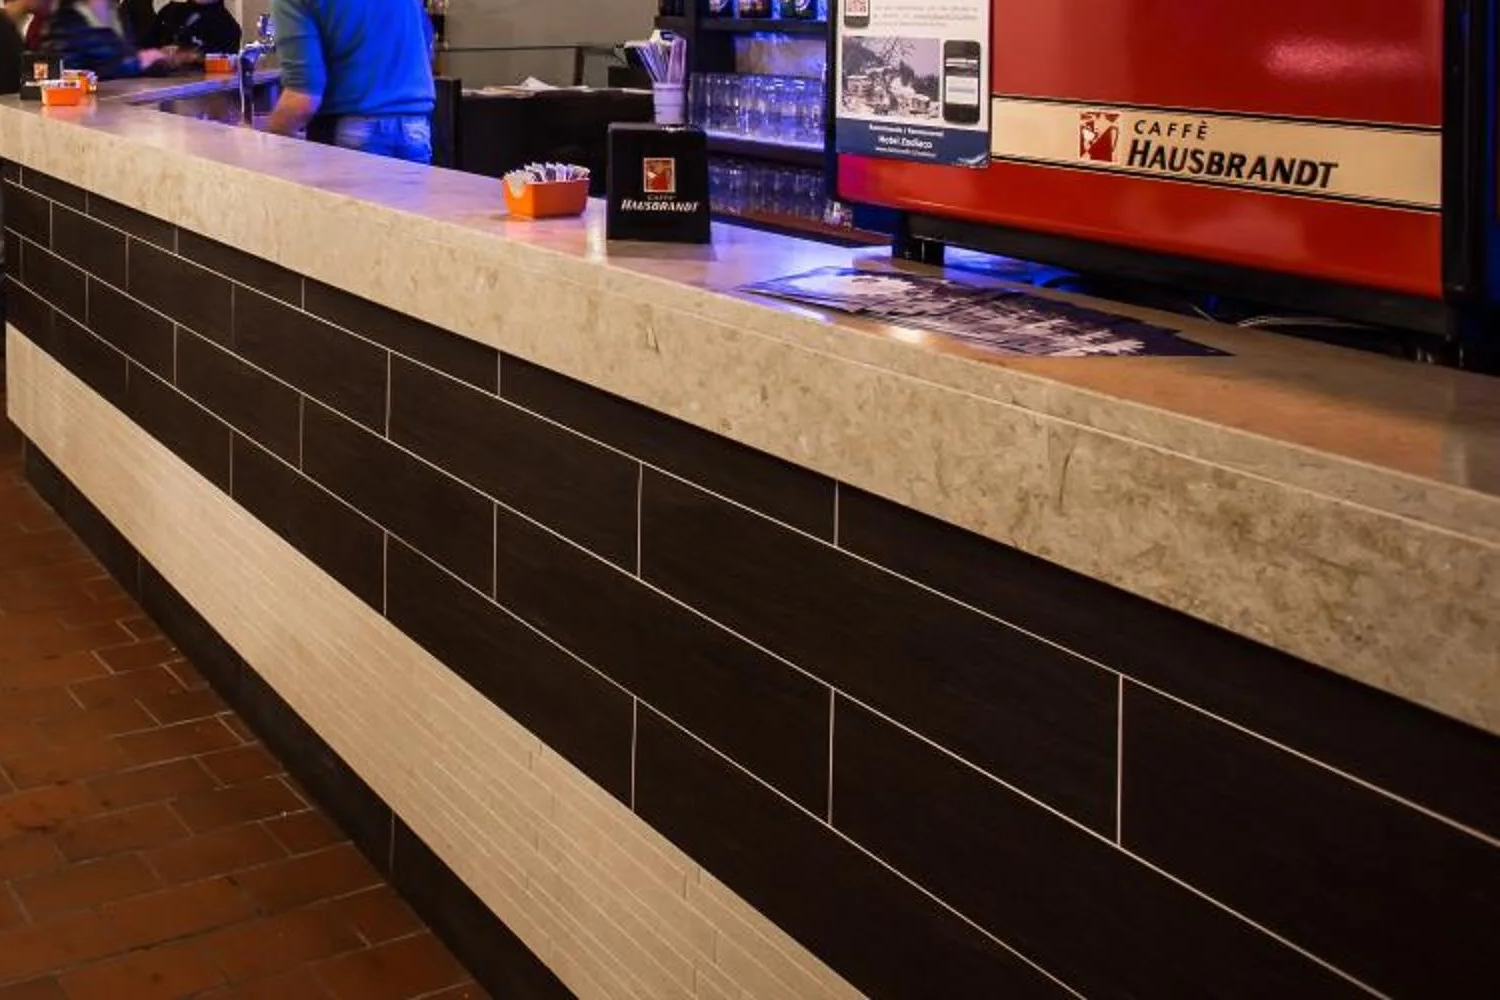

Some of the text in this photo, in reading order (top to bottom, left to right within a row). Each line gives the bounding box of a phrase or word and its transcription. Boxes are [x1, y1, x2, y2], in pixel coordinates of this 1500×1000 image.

[1133, 119, 1210, 141] CAFFÈ
[1126, 138, 1340, 189] HAUSBRANDT
[620, 199, 699, 213] HAUSBRANDT
